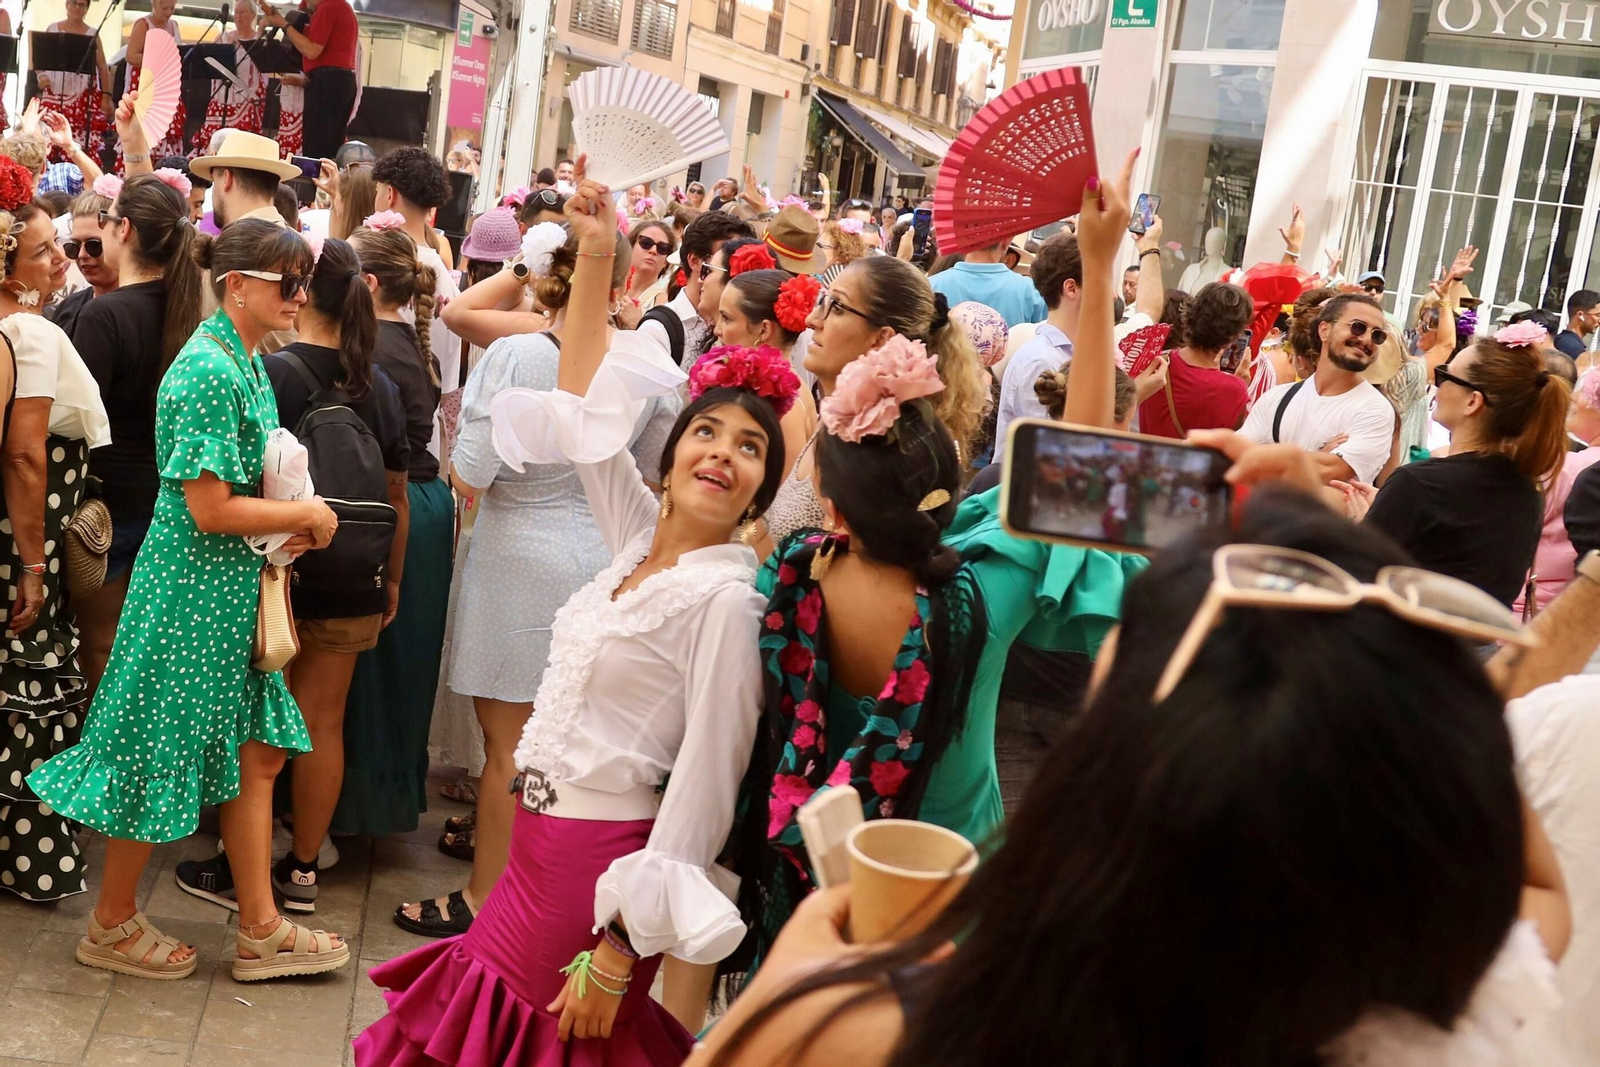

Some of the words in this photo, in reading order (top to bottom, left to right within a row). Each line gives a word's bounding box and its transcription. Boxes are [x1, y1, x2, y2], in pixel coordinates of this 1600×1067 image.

[1037, 0, 1100, 32] OYSHO
[1437, 0, 1599, 42] OYSH
[453, 54, 474, 68] #Summer
[451, 69, 473, 83] #Summer
